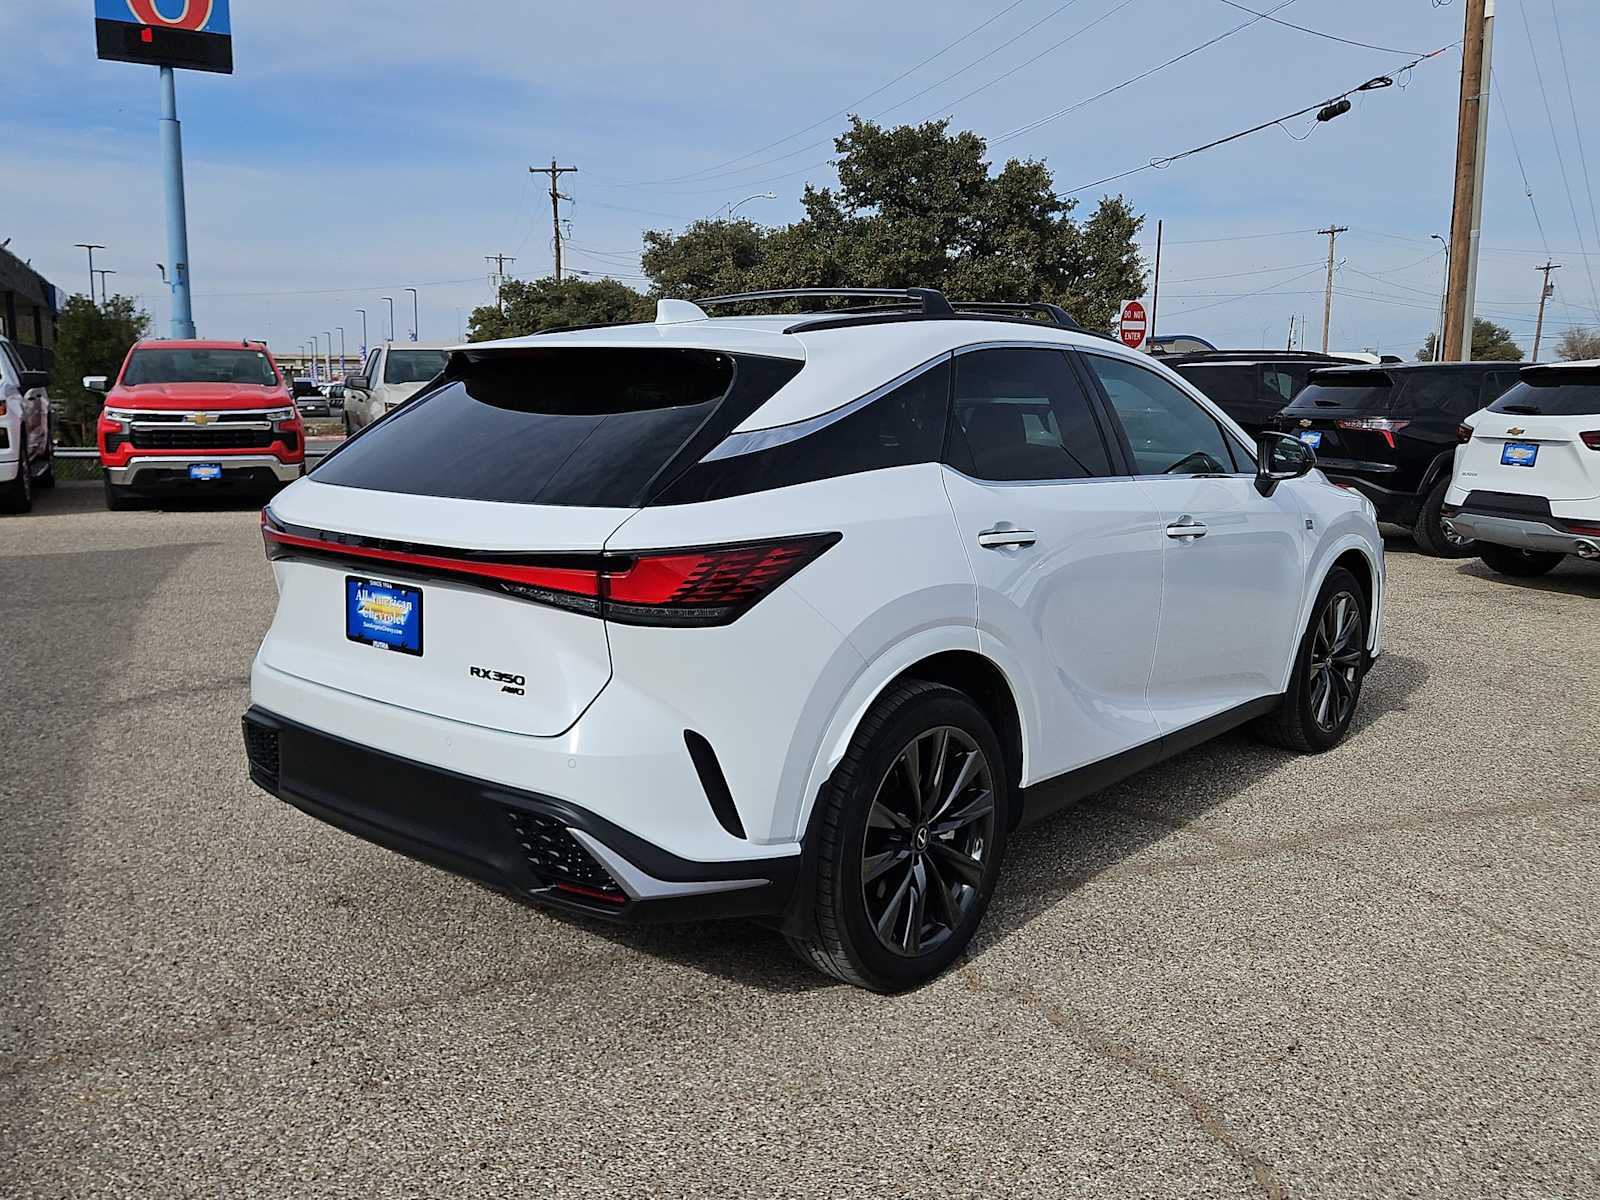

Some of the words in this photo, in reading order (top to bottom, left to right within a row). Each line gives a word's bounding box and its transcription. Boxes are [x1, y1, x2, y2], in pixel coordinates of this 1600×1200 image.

[1124, 310, 1132, 319] DO
[1133, 311, 1144, 319] NOT
[1124, 331, 1141, 341] ENTER
[355, 589, 369, 601] All
[369, 593, 411, 611] American
[362, 606, 405, 625] Chevrolet
[501, 685, 525, 696] AWD
